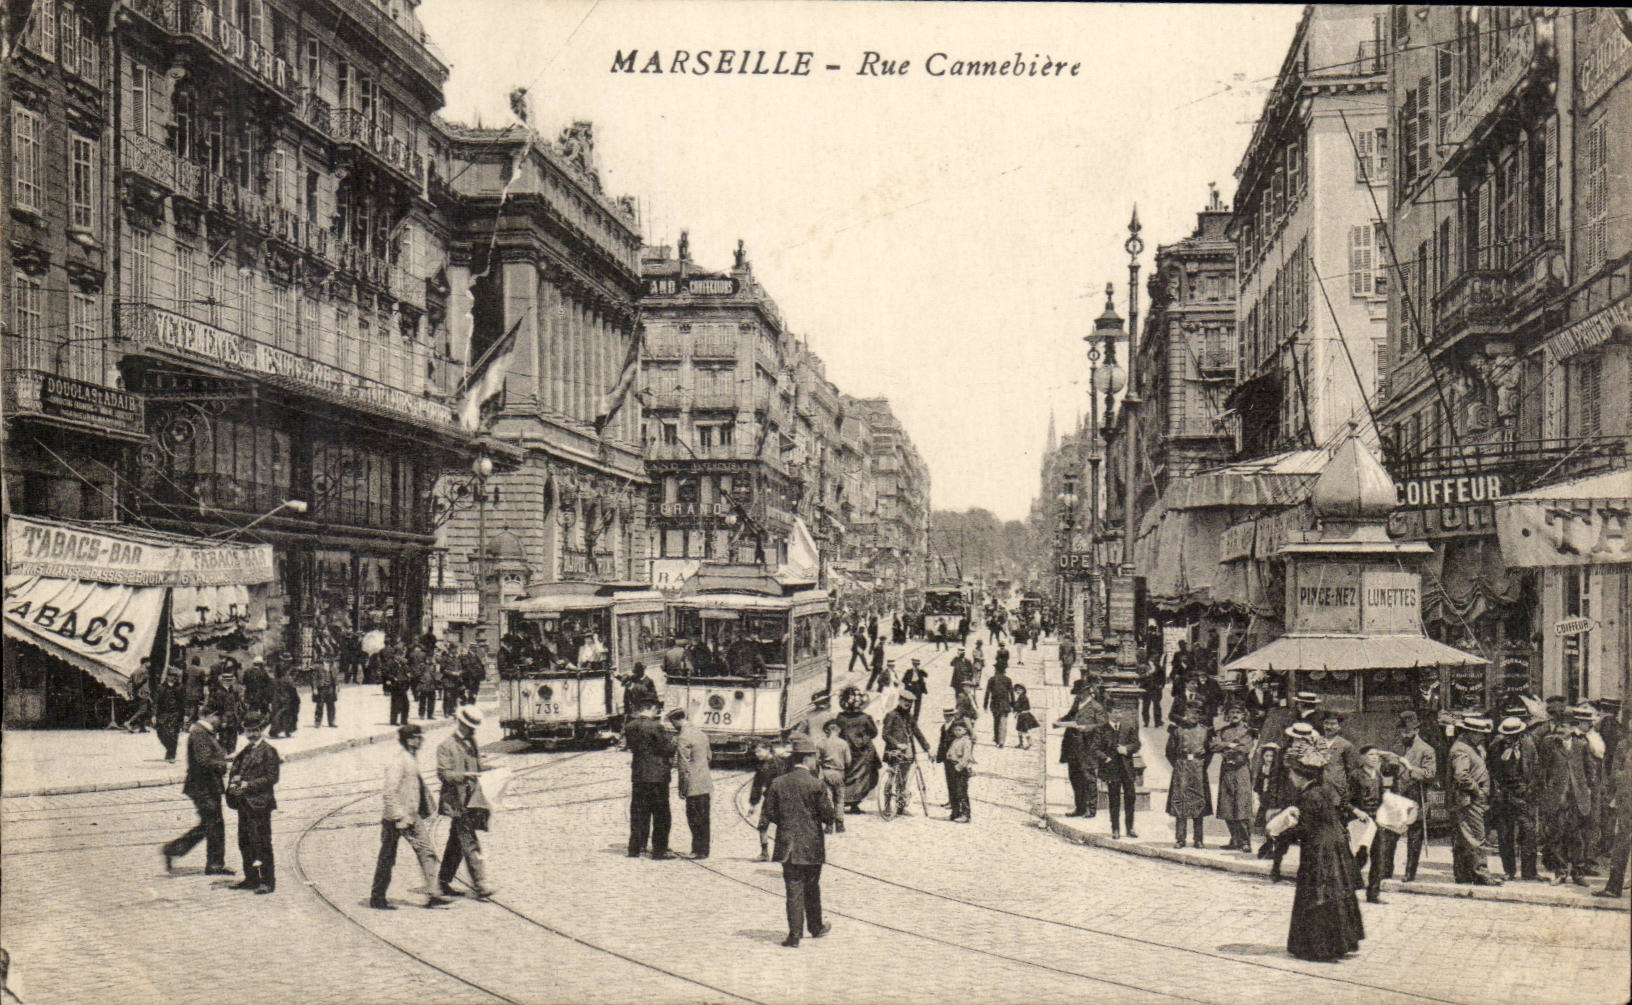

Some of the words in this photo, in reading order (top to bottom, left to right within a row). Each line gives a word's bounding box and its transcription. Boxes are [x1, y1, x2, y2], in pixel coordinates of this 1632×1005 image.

[48, 377, 97, 403] DOUGLAS
[104, 391, 136, 411] ADAIR
[1394, 475, 1501, 507] COIFFEUR
[1300, 587, 1356, 606] PINCE-NEZ
[1367, 588, 1417, 607] LUNETTES
[1556, 620, 1589, 634] COIFFEUR
[535, 703, 560, 715] 732
[704, 711, 732, 725] 708
